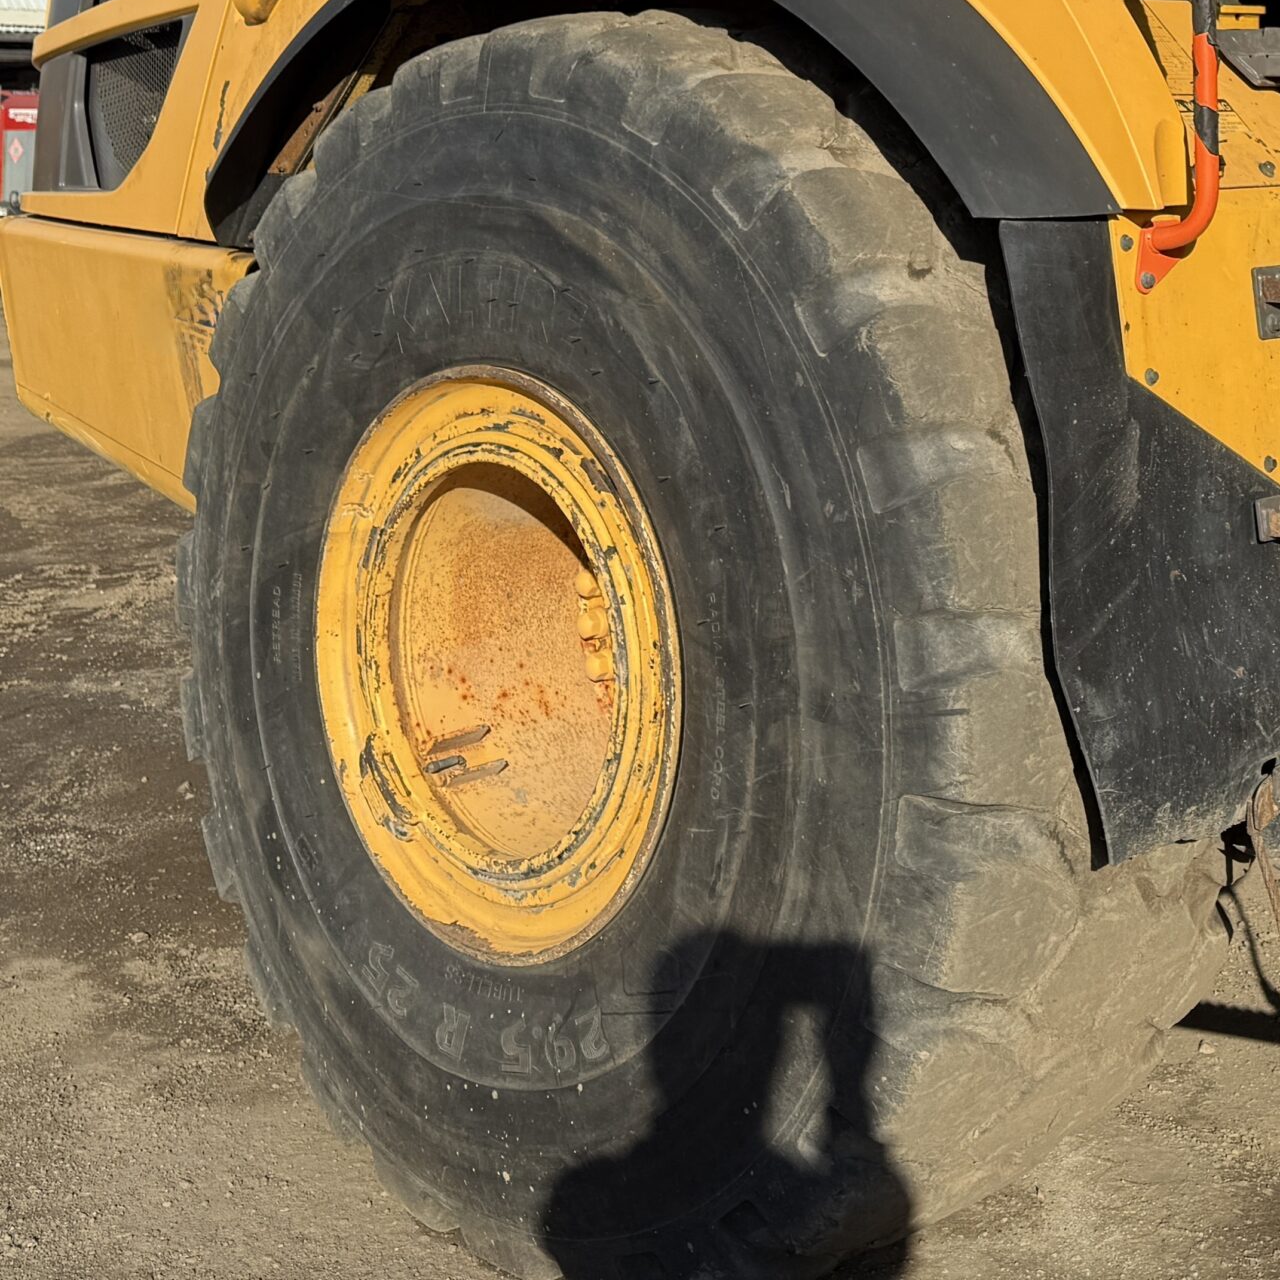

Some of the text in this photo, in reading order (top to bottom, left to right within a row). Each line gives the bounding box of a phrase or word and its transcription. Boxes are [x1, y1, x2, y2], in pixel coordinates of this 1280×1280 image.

[715, 676, 725, 736] STEEL
[710, 745, 724, 800] CORD
[360, 940, 419, 1018] 25
[434, 1002, 471, 1061] R
